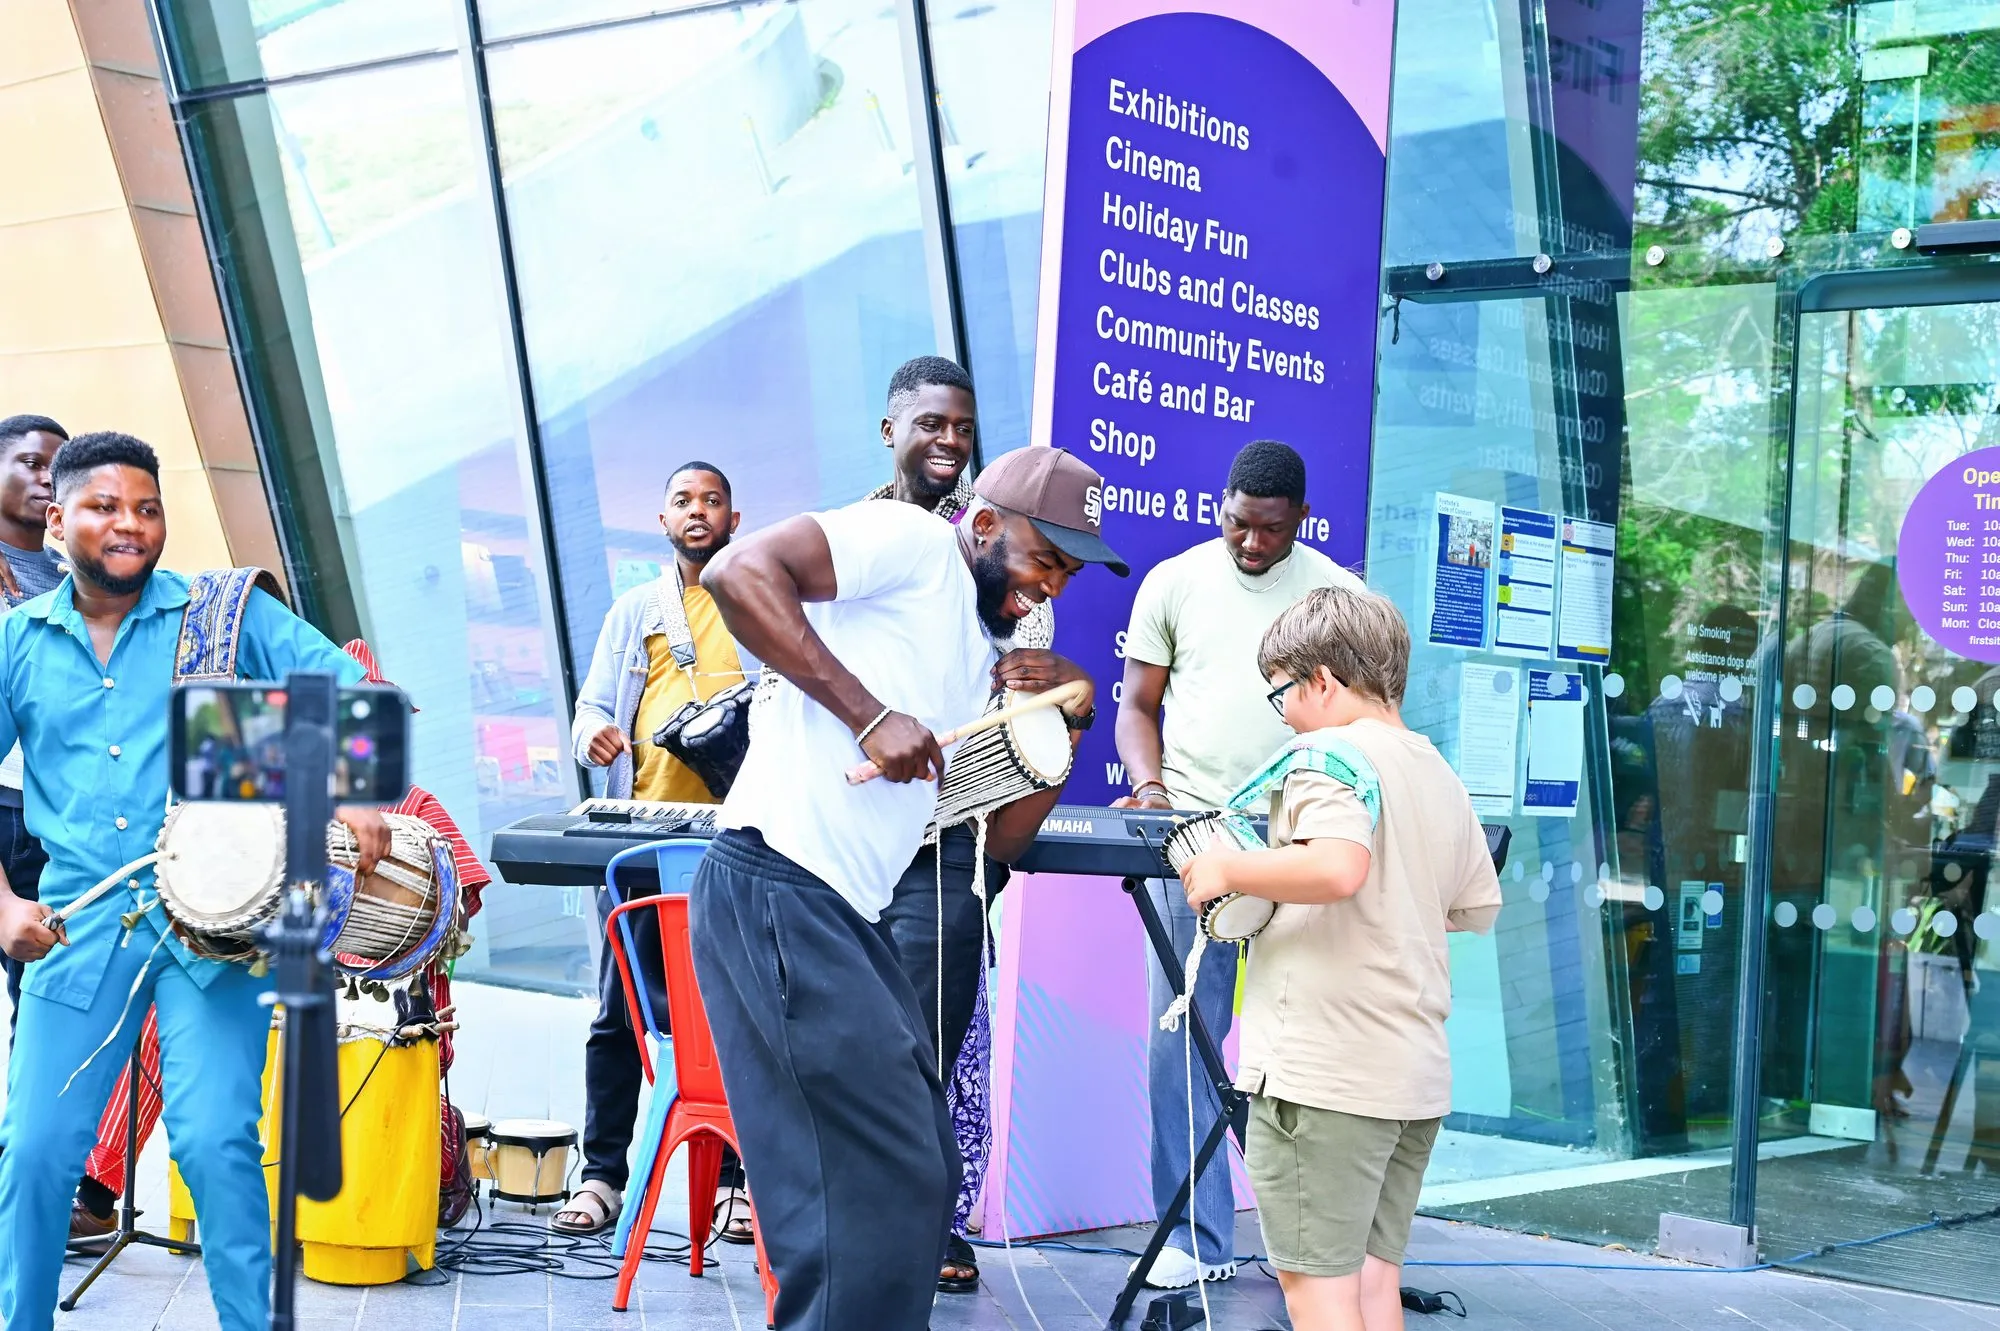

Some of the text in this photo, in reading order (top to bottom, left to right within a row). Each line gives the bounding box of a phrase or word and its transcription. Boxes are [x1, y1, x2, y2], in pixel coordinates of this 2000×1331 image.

[1109, 78, 1250, 151] Exhibitions
[1105, 136, 1202, 192] Cinema
[1102, 191, 1248, 260] Holiday Fun
[1099, 248, 1320, 331] Clubs and Classes
[1096, 305, 1325, 384] Community Events
[1093, 361, 1255, 423] Café and Bar
[1089, 418, 1156, 467] Shop
[1100, 477, 1166, 519] enue
[1172, 488, 1189, 522] &
[1296, 517, 1330, 542] ire
[1946, 520, 2000, 531] Tue: 10
[1946, 536, 1975, 547] Wed:
[1944, 552, 1970, 564] Thu:
[1944, 568, 1962, 580] Fri:
[1943, 584, 1966, 596] Sat:
[1942, 601, 1968, 612] Sun:
[1687, 622, 1731, 644] No Smoking
[1941, 617, 1970, 629] Mon:
[1685, 649, 1726, 666] Assistance
[1726, 654, 1745, 671] dogs
[1684, 669, 1718, 683] welcome
[1040, 819, 1093, 834] AMAHA
